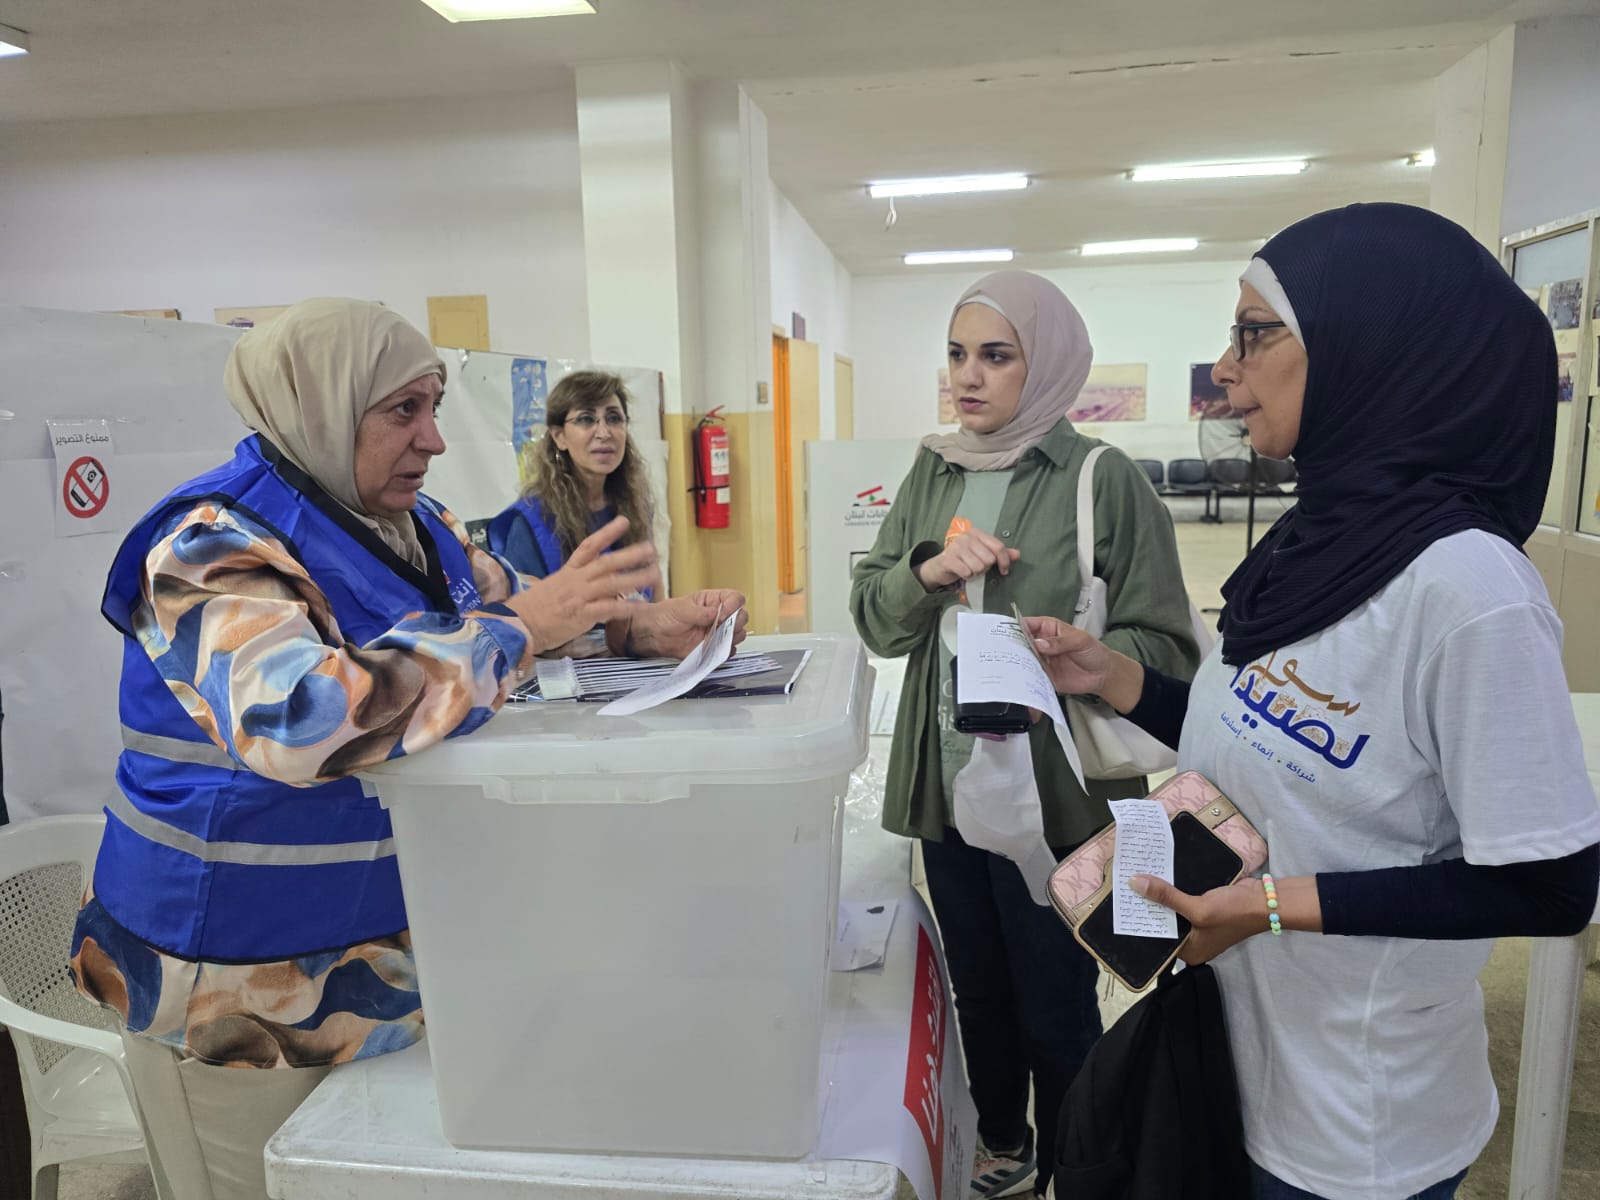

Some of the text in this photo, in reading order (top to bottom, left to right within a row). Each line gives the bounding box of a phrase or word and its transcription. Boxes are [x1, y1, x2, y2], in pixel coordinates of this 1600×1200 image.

[55, 433, 109, 446] ممنوع التصوير
[1230, 664, 1371, 770] لصيدا
[1251, 741, 1274, 760] إنماء
[1286, 761, 1316, 784] شراكة
